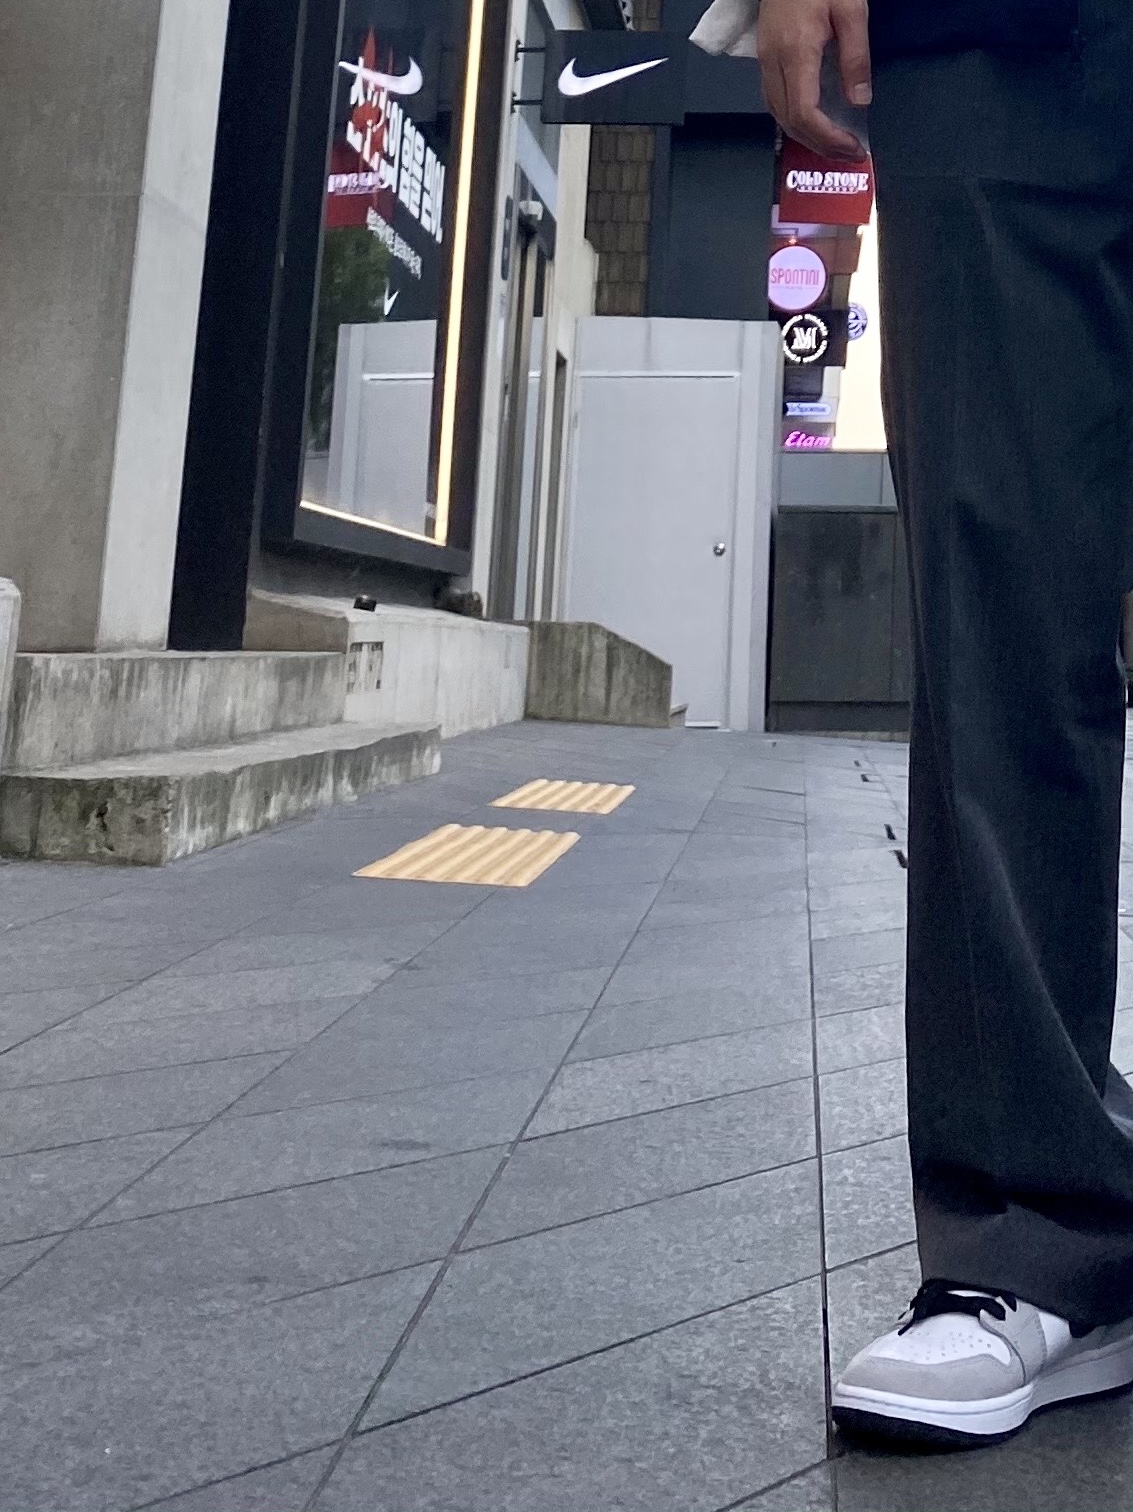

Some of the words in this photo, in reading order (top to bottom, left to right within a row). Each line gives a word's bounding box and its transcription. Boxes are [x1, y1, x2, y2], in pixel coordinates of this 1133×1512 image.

[786, 170, 823, 189] COLD
[823, 171, 869, 191] STONE
[770, 267, 820, 286] SPONTINI
